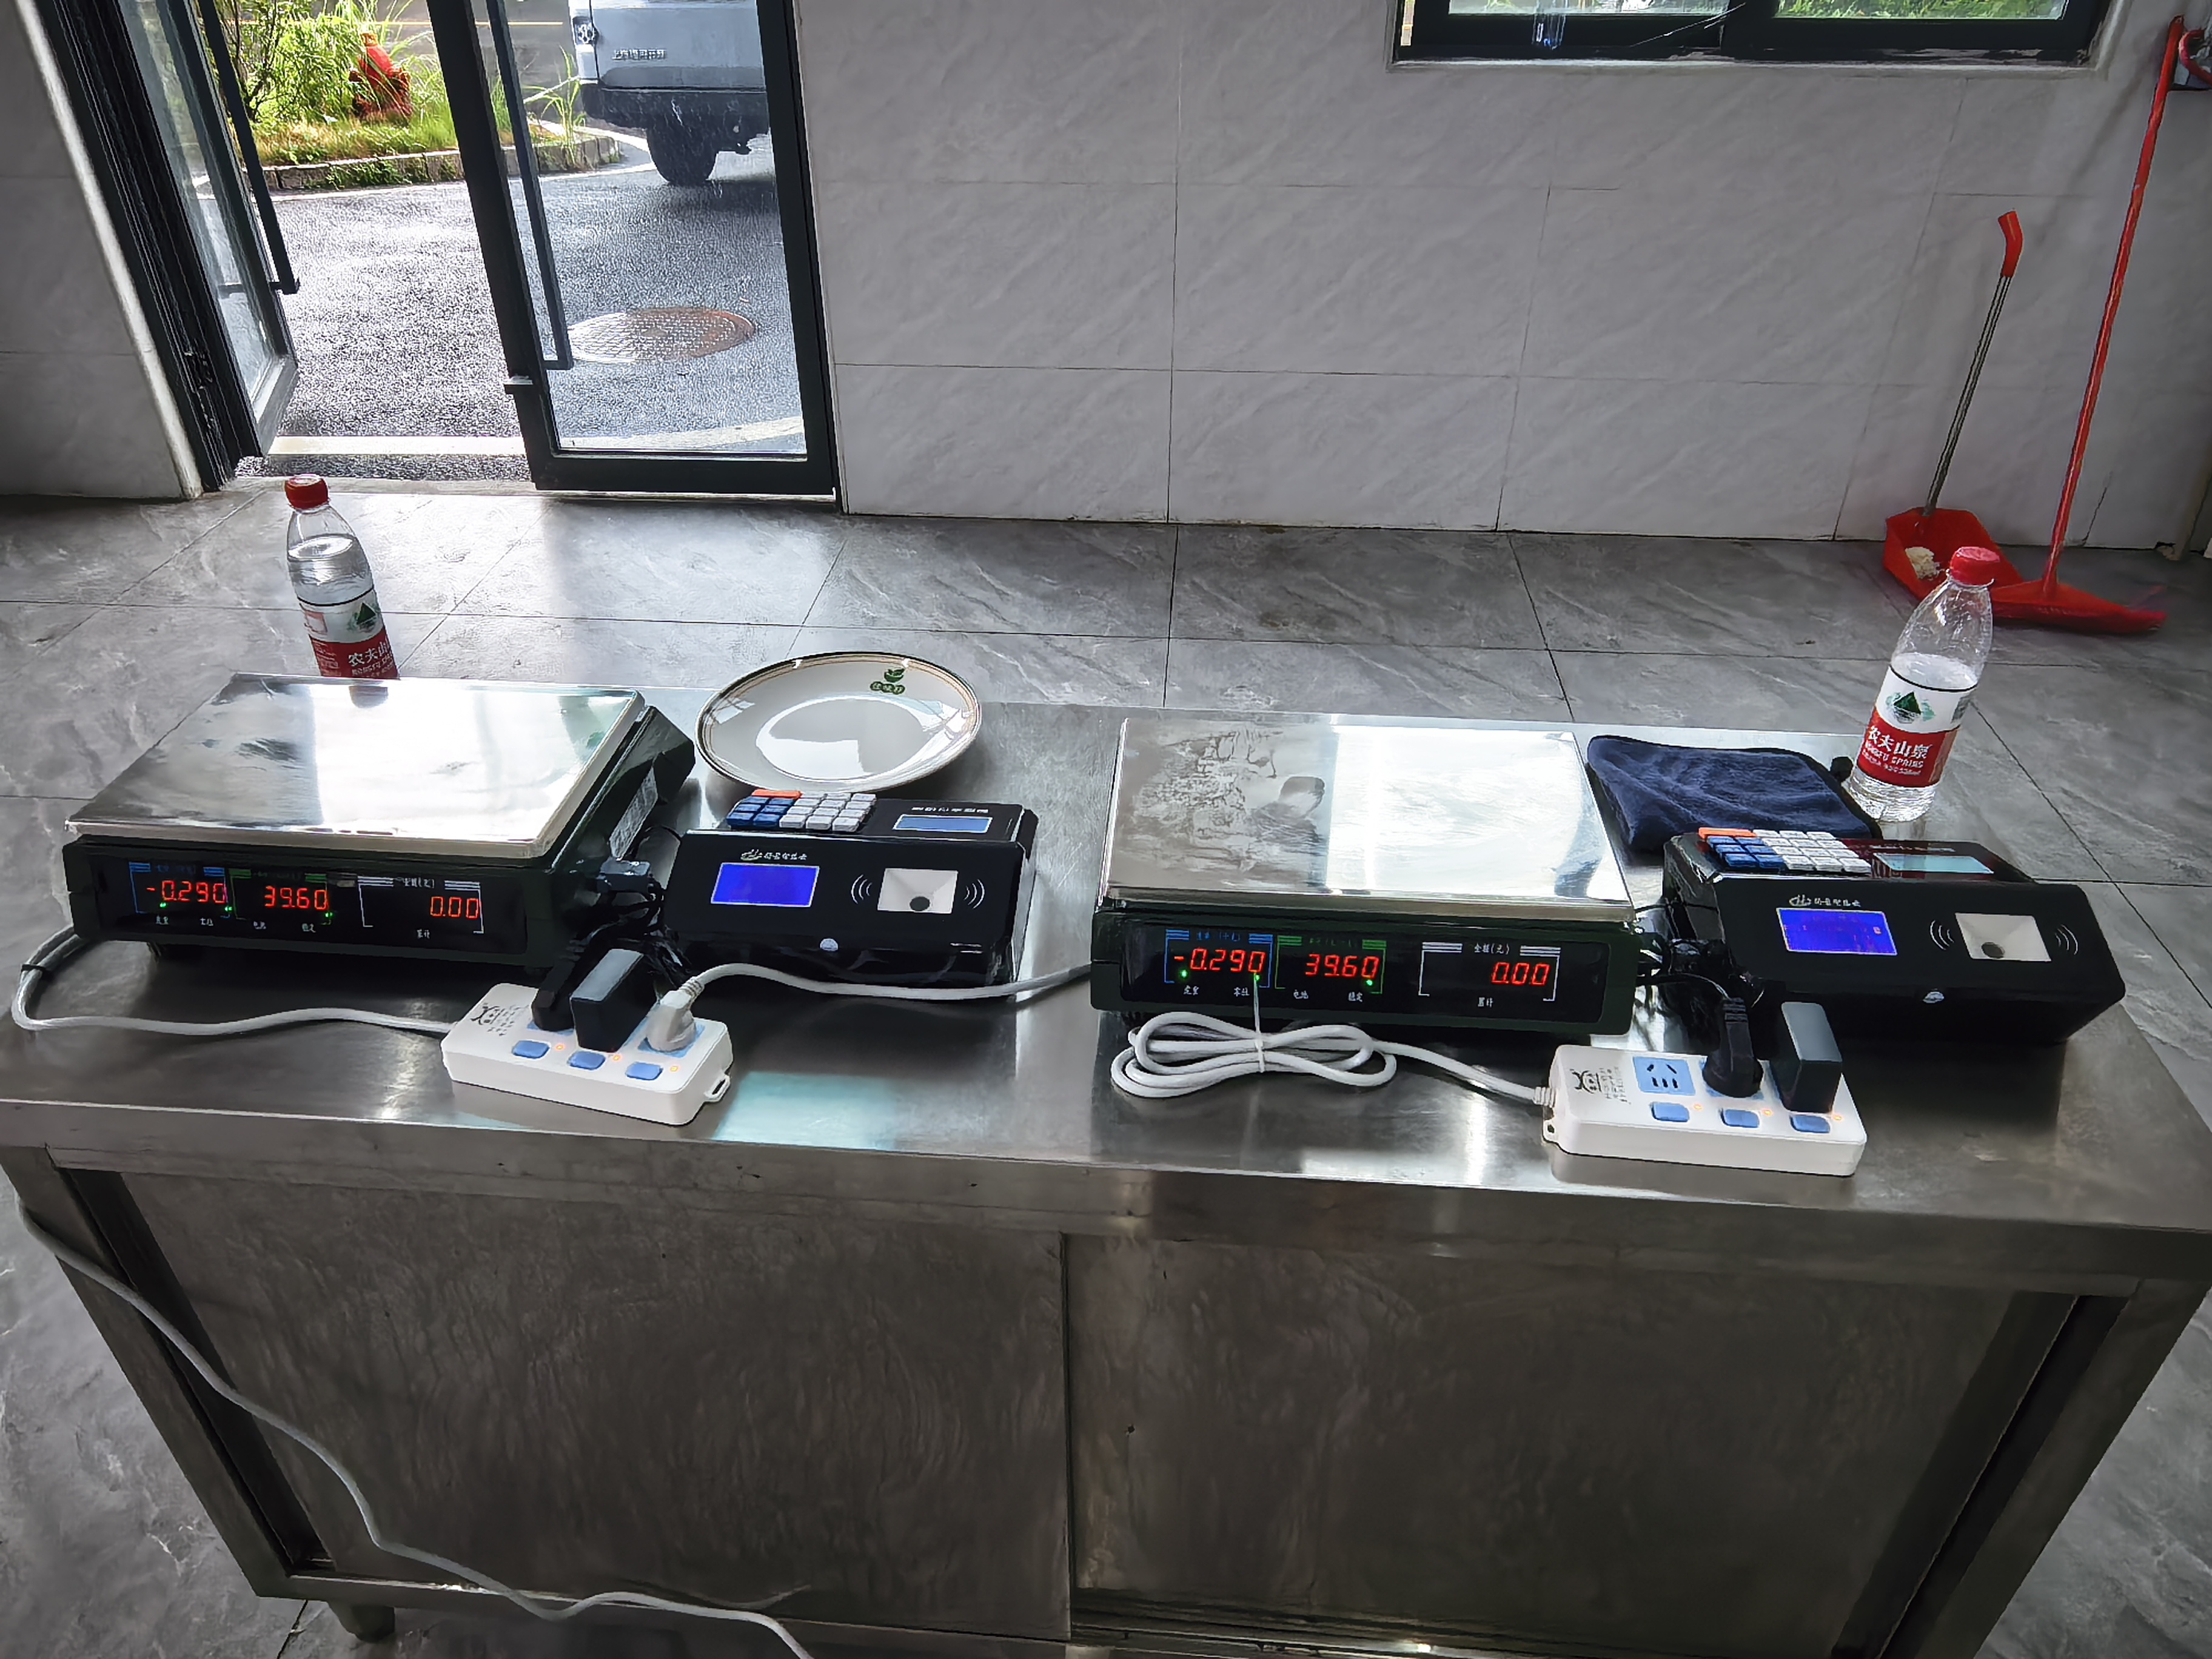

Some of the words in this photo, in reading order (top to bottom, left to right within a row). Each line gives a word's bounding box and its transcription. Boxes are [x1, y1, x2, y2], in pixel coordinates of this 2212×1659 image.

[349, 637, 391, 666] 农夫山
[1869, 725, 1932, 759] 农夫山泉
[147, 880, 227, 903] -0.290
[264, 885, 329, 910] 39.60
[430, 896, 478, 918] 0.00
[1174, 948, 1265, 973] -0.290
[1305, 954, 1379, 979] 39.60
[1492, 962, 1550, 985] 0.00
